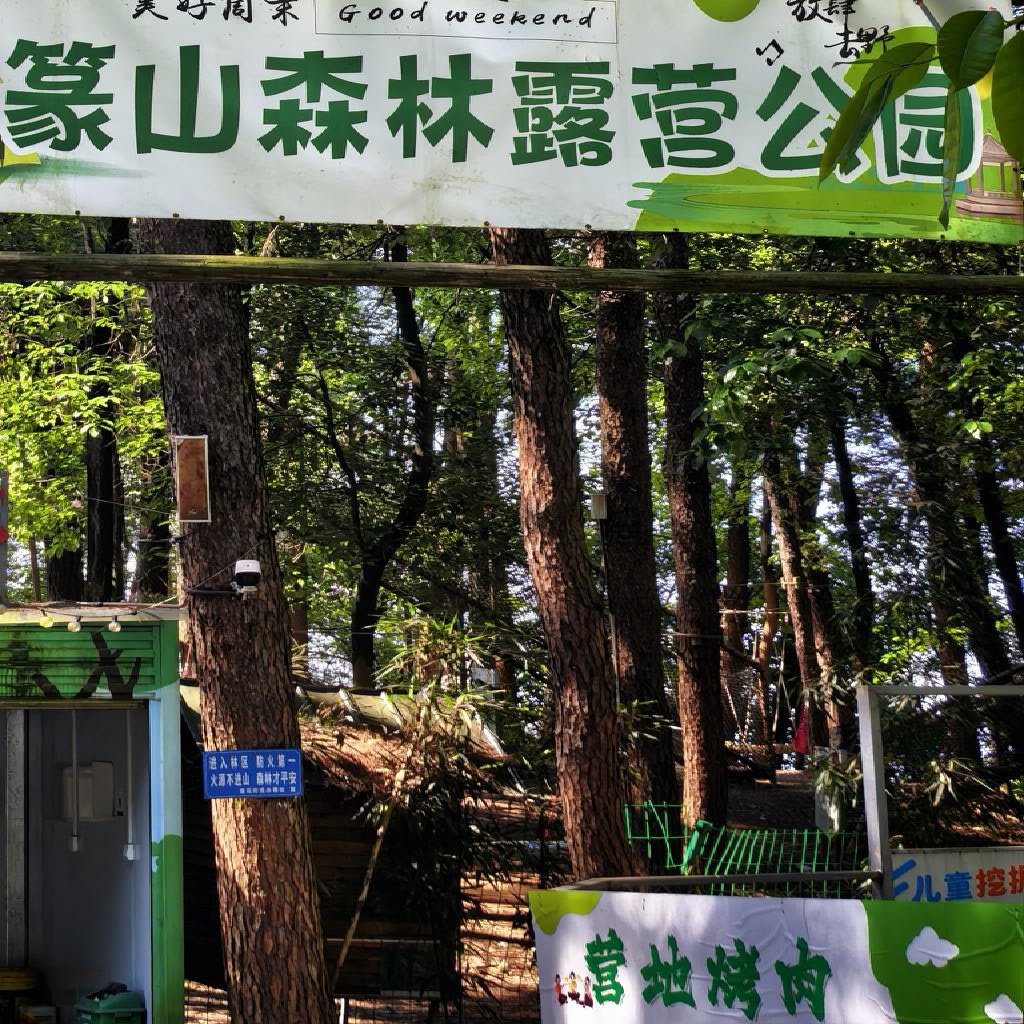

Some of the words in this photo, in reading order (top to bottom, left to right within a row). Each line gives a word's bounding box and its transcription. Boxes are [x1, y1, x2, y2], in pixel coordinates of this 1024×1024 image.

[339, 1, 428, 23] Good
[445, 7, 596, 28] weekend
[584, 928, 833, 1022] 营地烤肉
